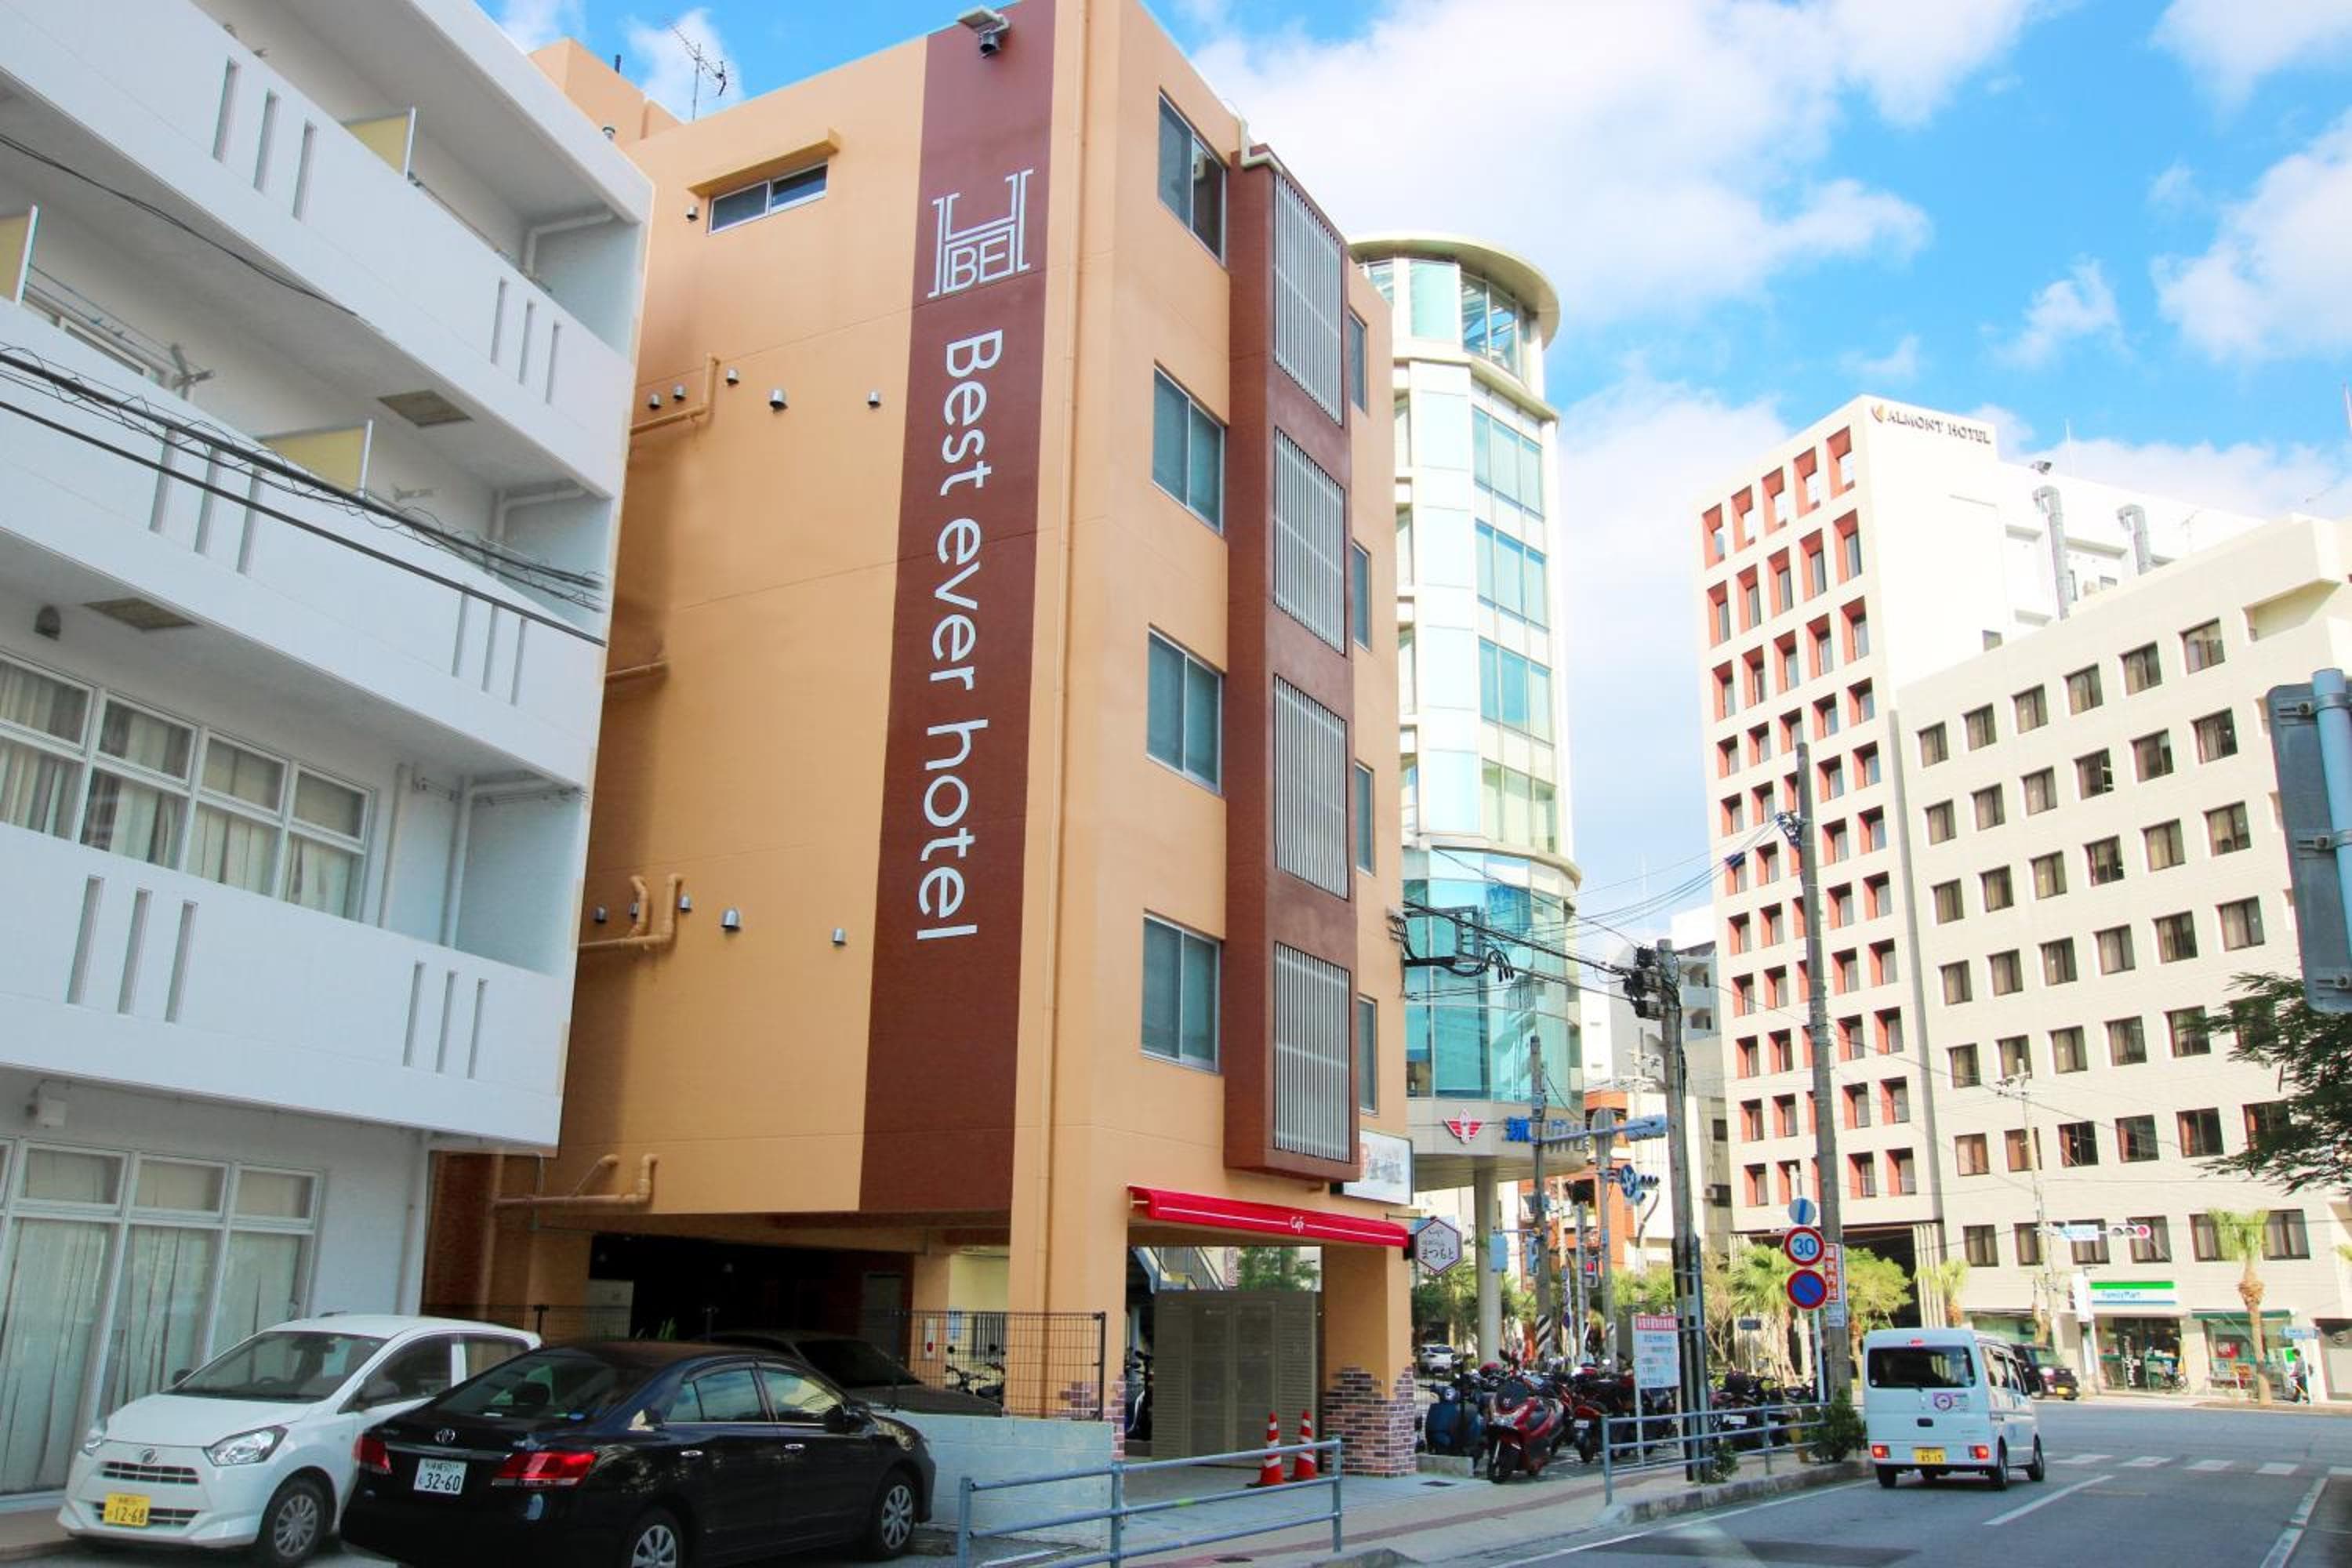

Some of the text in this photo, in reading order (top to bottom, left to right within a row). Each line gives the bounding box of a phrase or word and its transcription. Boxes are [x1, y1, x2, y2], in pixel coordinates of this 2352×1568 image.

[1886, 411, 1991, 445] ALMONT HOTEL
[916, 328, 1004, 940] Best ever hotel
[1792, 1238, 1817, 1256] 30
[424, 1473, 461, 1491] 32-60
